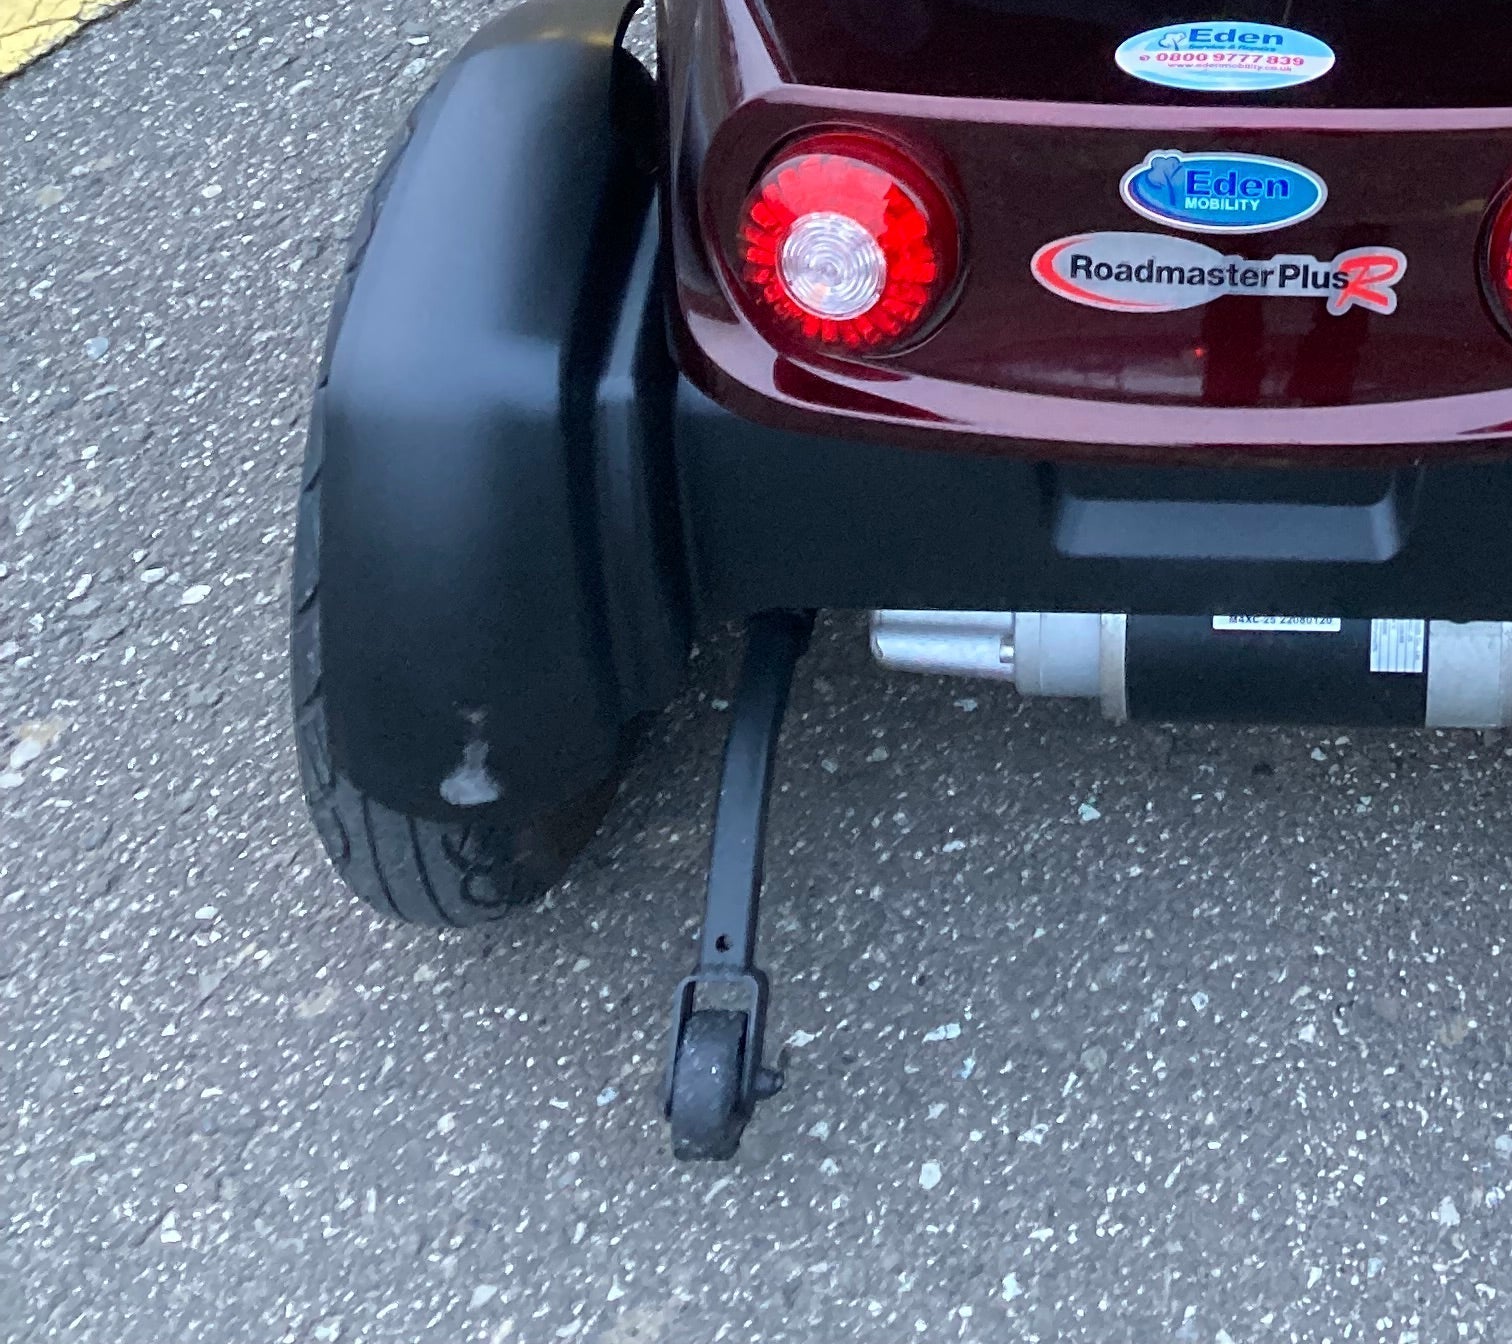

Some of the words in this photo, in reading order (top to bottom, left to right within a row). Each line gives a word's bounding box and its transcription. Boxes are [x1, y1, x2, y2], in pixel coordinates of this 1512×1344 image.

[1189, 28, 1283, 45] Eden
[1156, 52, 1208, 62] 0800
[1213, 52, 1262, 63] 9777
[1266, 55, 1304, 66] 839
[1184, 169, 1290, 198] Eden
[1184, 197, 1260, 211] MOBILITY
